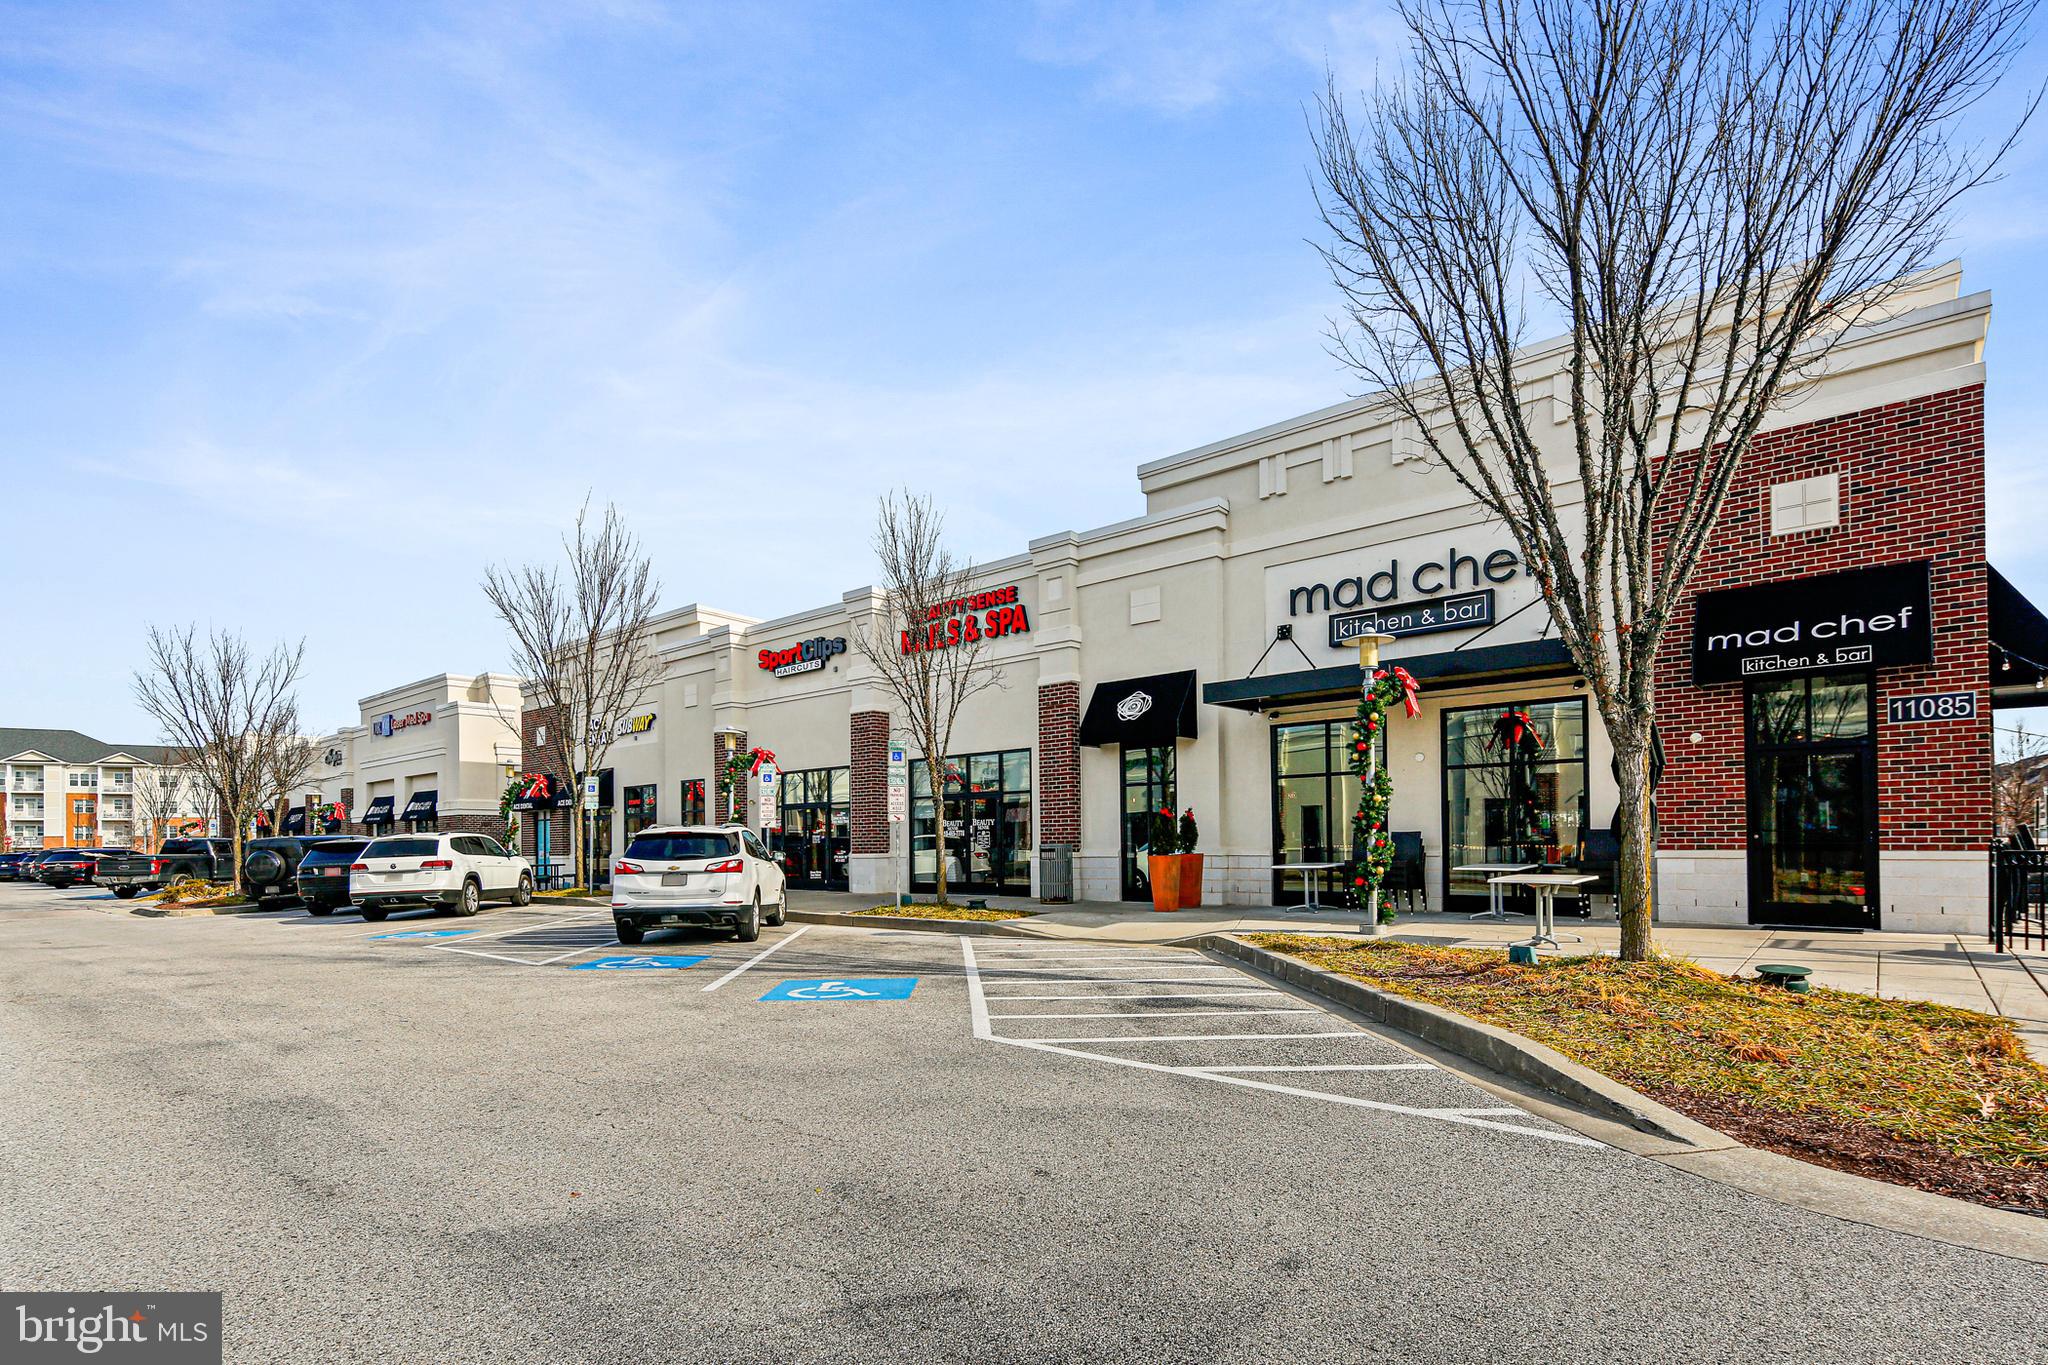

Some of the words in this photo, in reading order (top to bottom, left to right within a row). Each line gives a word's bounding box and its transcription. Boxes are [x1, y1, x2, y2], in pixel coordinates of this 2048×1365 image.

[967, 585, 1018, 611] SENSE
[1289, 558, 1398, 617] mad
[964, 614, 980, 643] &
[984, 604, 1029, 639] SPA
[1421, 608, 1436, 625] &
[1444, 601, 1483, 622] bar
[1707, 620, 1801, 651] mad
[1810, 606, 1913, 639] chef
[776, 660, 820, 676] HAIRCUTS
[1745, 655, 1810, 673] kitchen
[1816, 653, 1830, 664] &
[1836, 648, 1868, 663] bar
[1891, 696, 1971, 720] 11085
[617, 713, 656, 736] SUBWAY
